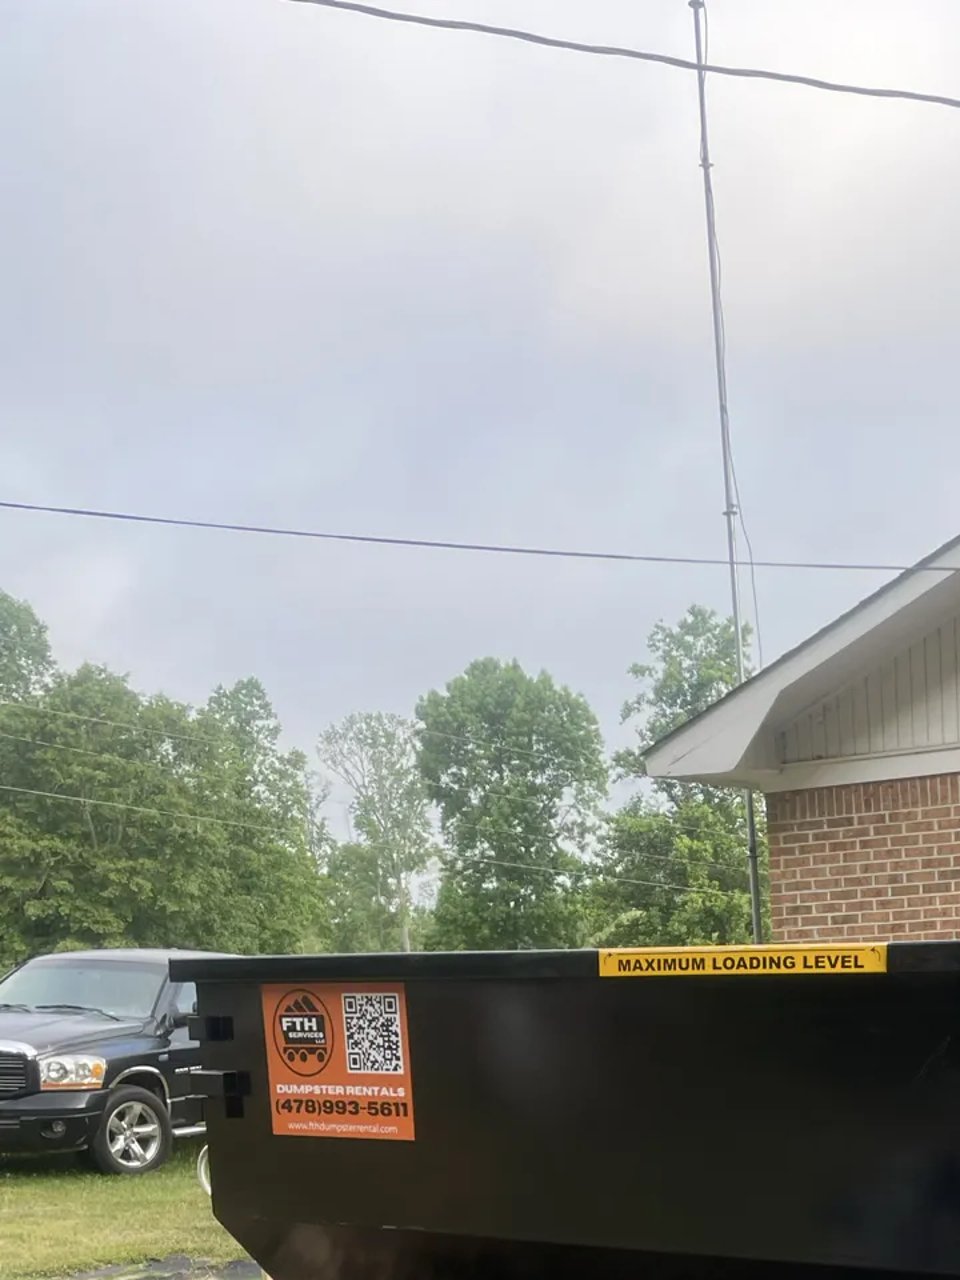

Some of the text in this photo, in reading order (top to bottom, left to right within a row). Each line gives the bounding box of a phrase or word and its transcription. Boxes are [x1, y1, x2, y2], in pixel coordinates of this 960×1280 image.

[617, 954, 865, 972] MAXIMUM LOADING LEVEL
[281, 1017, 318, 1031] FTH
[288, 1031, 324, 1039] SERVICES
[276, 1084, 406, 1097] DUMPSTER RENTALS
[275, 1099, 409, 1117] (478)993-5611
[287, 1120, 398, 1135] www.fthdumpsterrental.com
